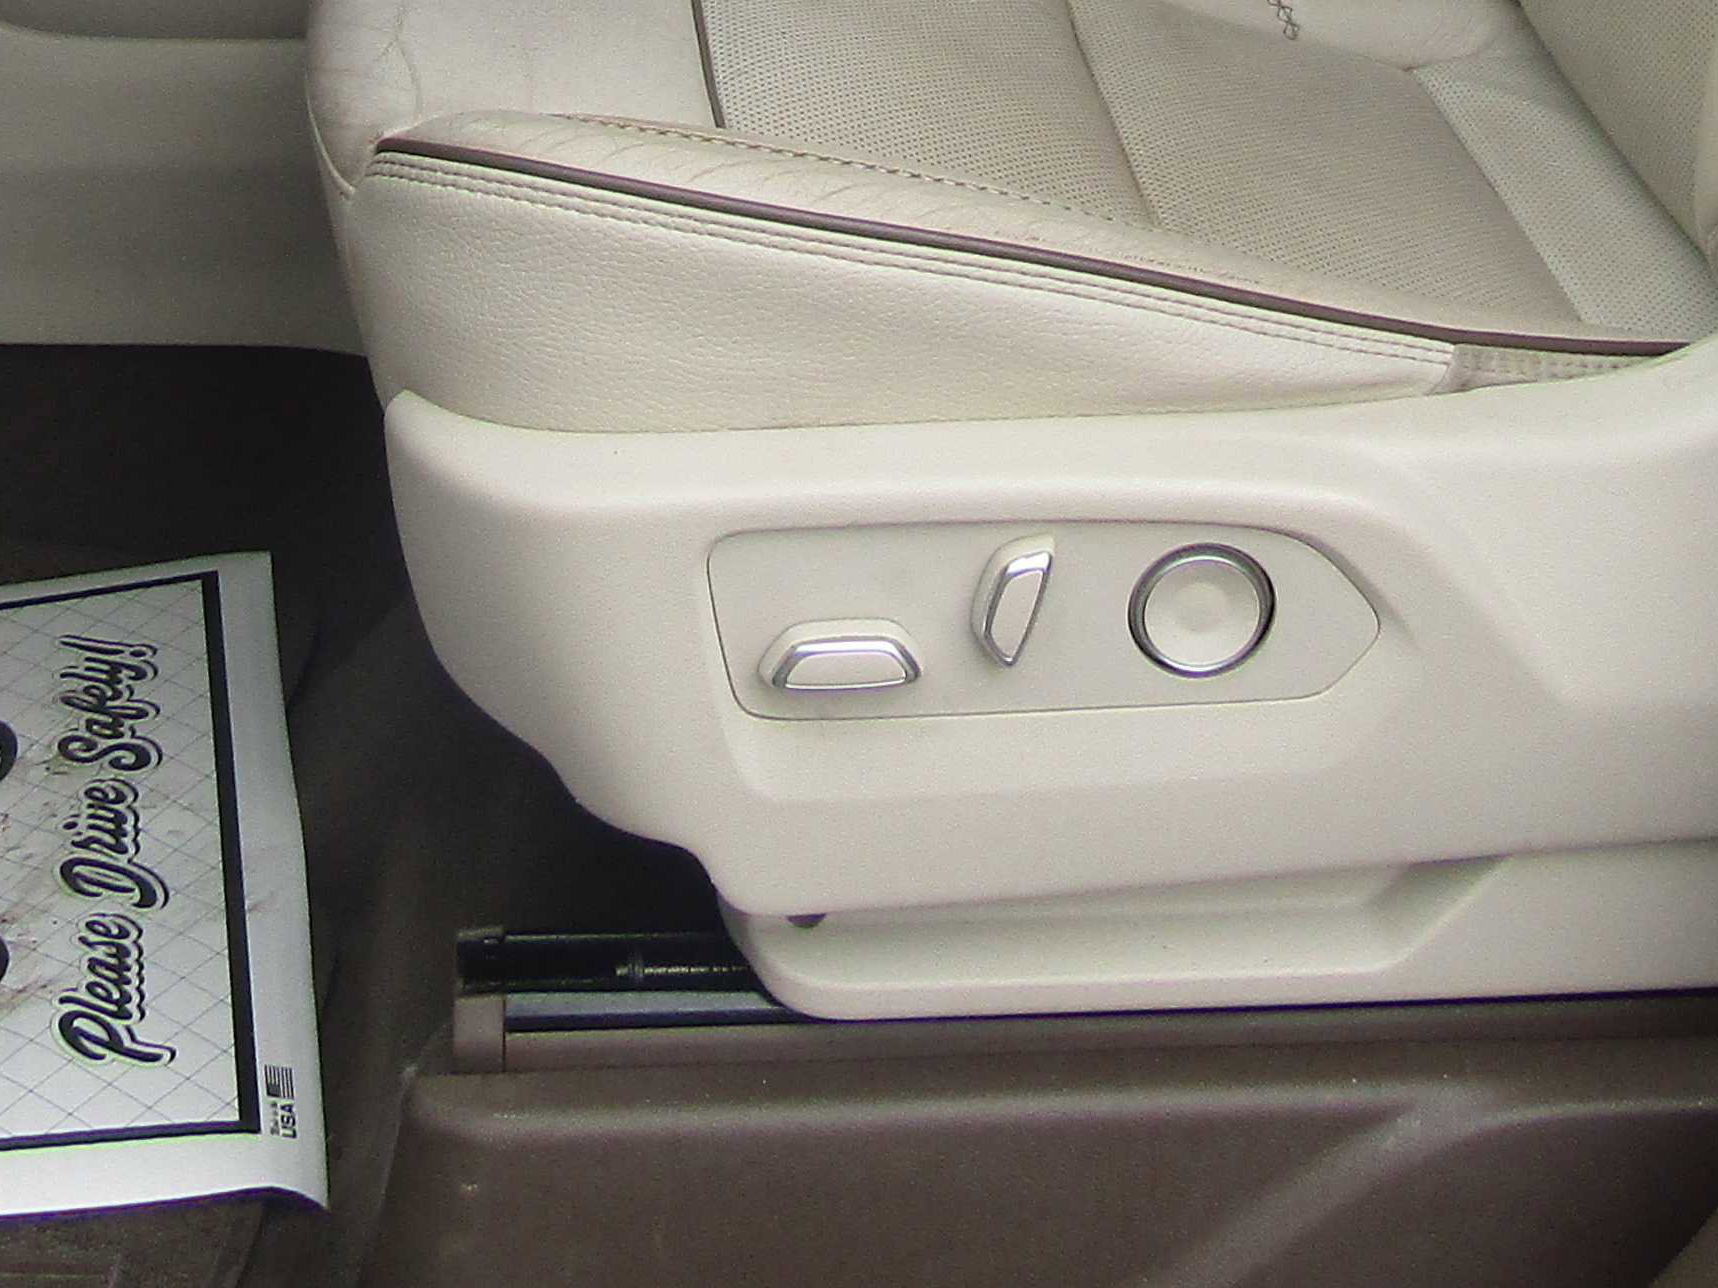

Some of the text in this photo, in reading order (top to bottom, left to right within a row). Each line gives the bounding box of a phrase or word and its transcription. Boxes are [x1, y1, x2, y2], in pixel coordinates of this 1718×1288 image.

[57, 635, 175, 1066] Please Drive Safely!
[281, 1104, 297, 1139] USA
